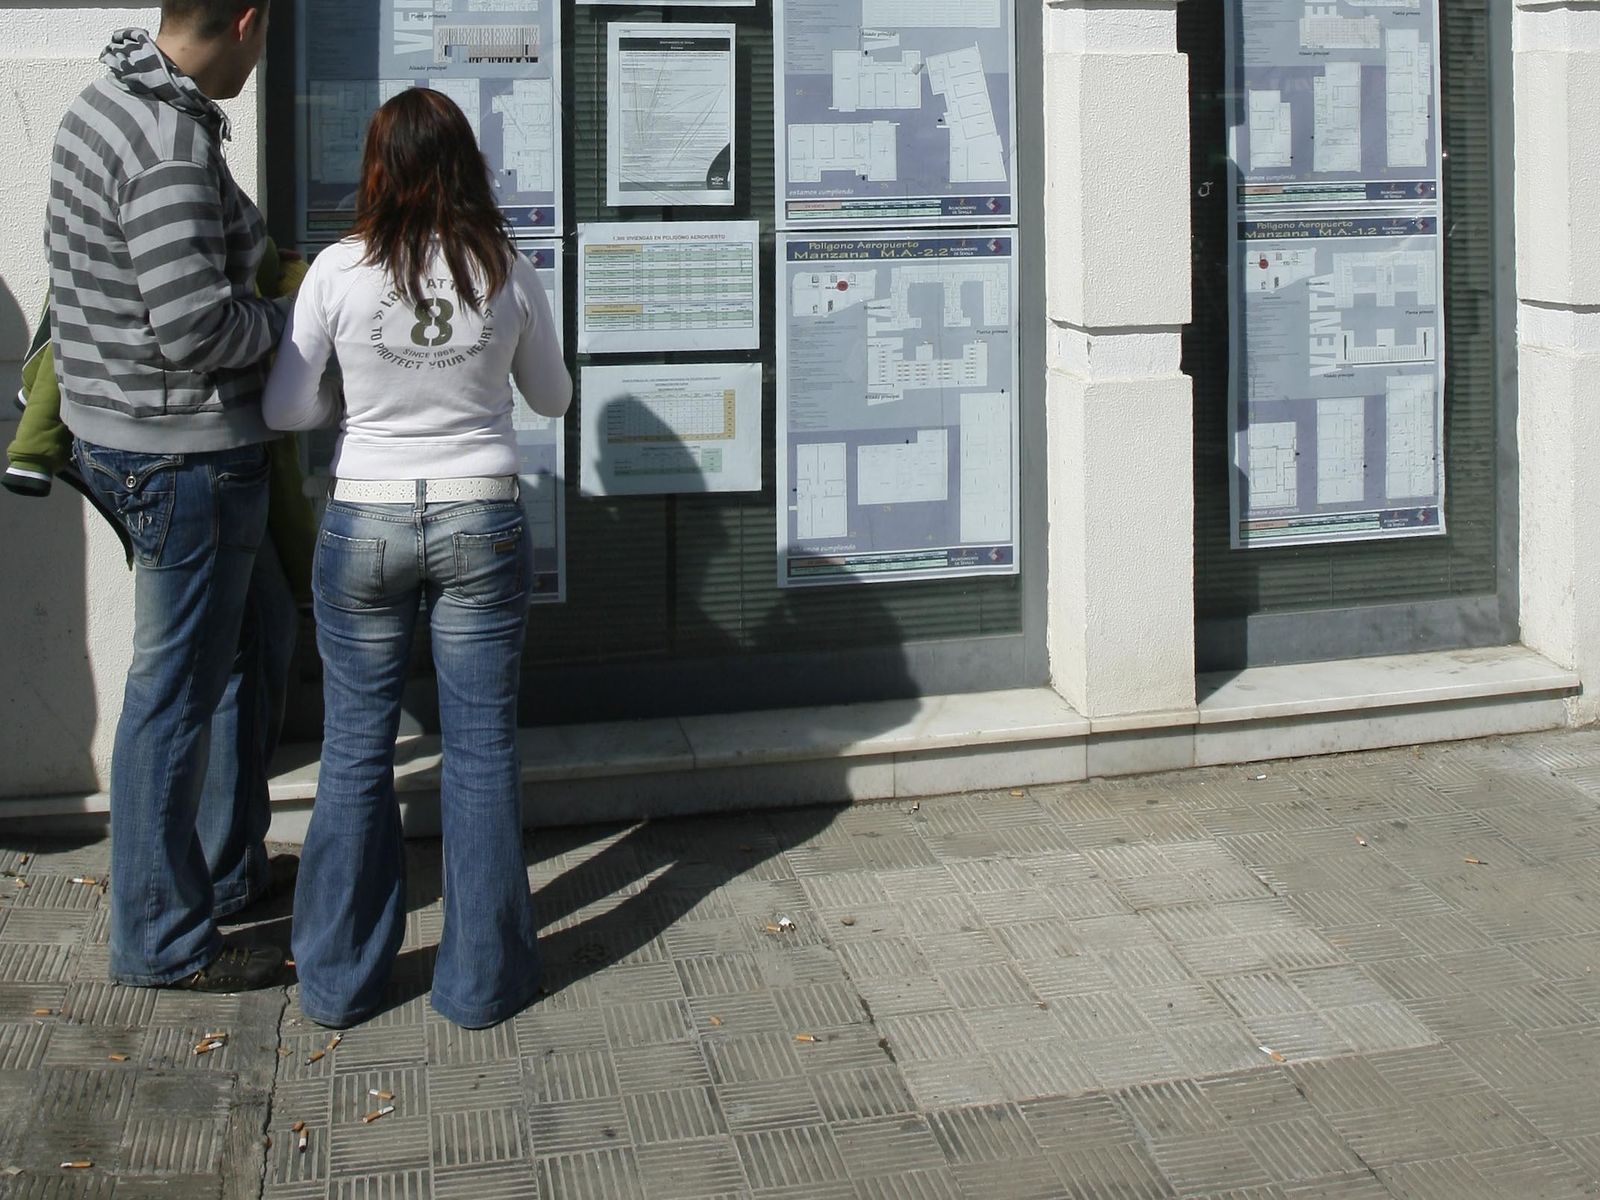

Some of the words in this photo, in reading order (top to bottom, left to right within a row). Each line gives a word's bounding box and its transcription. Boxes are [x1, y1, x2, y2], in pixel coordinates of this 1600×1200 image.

[1245, 229, 1309, 238] Manzana
[1318, 227, 1377, 236] M.A.-1.2
[1298, 221, 1353, 230] Aeropuerto
[857, 240, 919, 250] Aeropuerto
[794, 250, 869, 260] Manzana
[880, 248, 948, 258] M.A.-2.2
[410, 297, 454, 347] 8
[370, 326, 383, 342] TO
[466, 325, 494, 358] HEART
[373, 343, 424, 370] PROTECT
[402, 348, 430, 359] SINCE
[428, 354, 466, 370] YOUR
